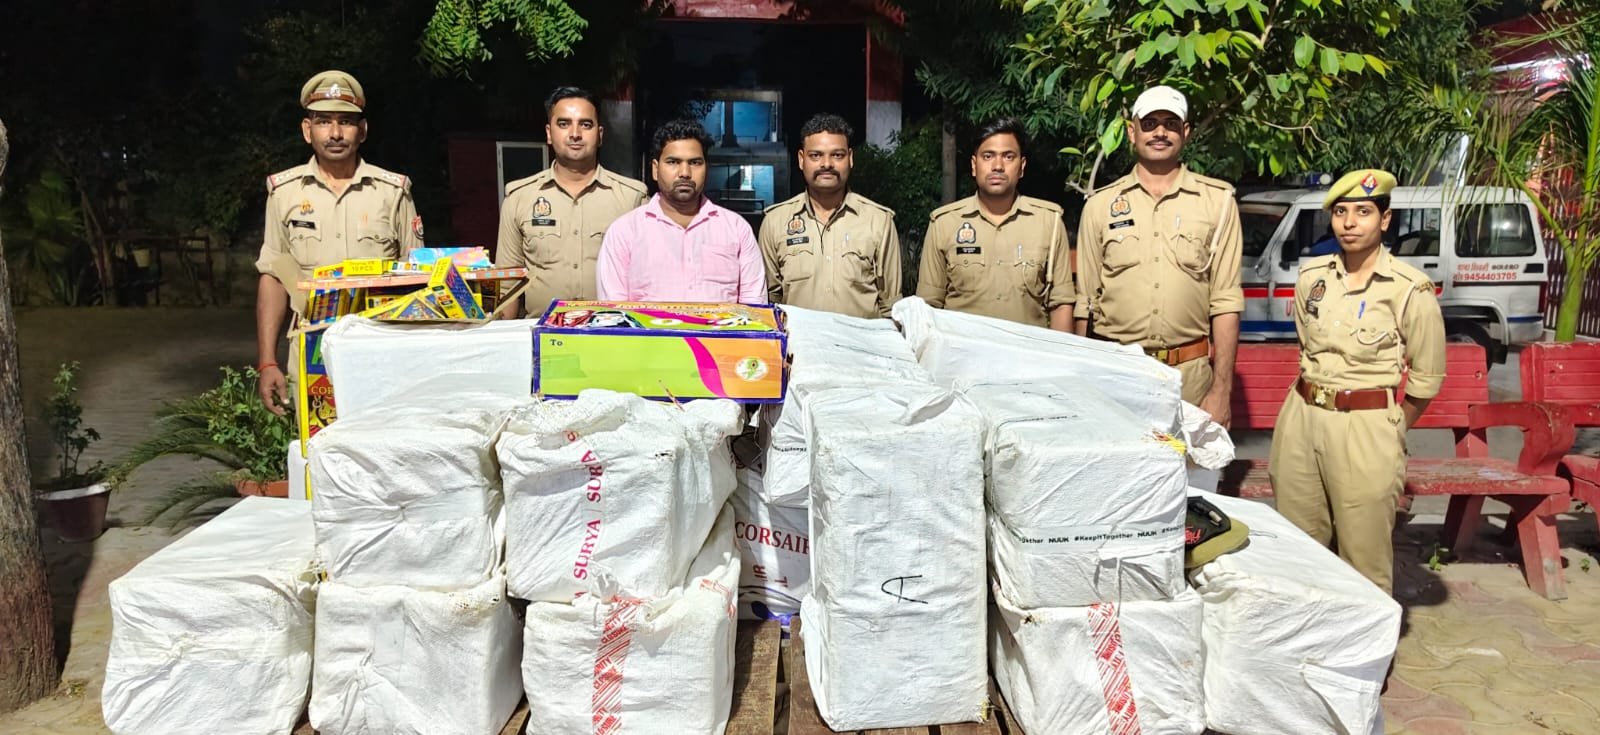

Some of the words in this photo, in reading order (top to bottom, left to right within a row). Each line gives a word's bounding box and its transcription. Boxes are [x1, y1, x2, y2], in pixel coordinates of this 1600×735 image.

[550, 338, 563, 347] To
[581, 450, 603, 503] SURA
[573, 519, 601, 580] SURYA
[1138, 530, 1157, 538] NUUK
